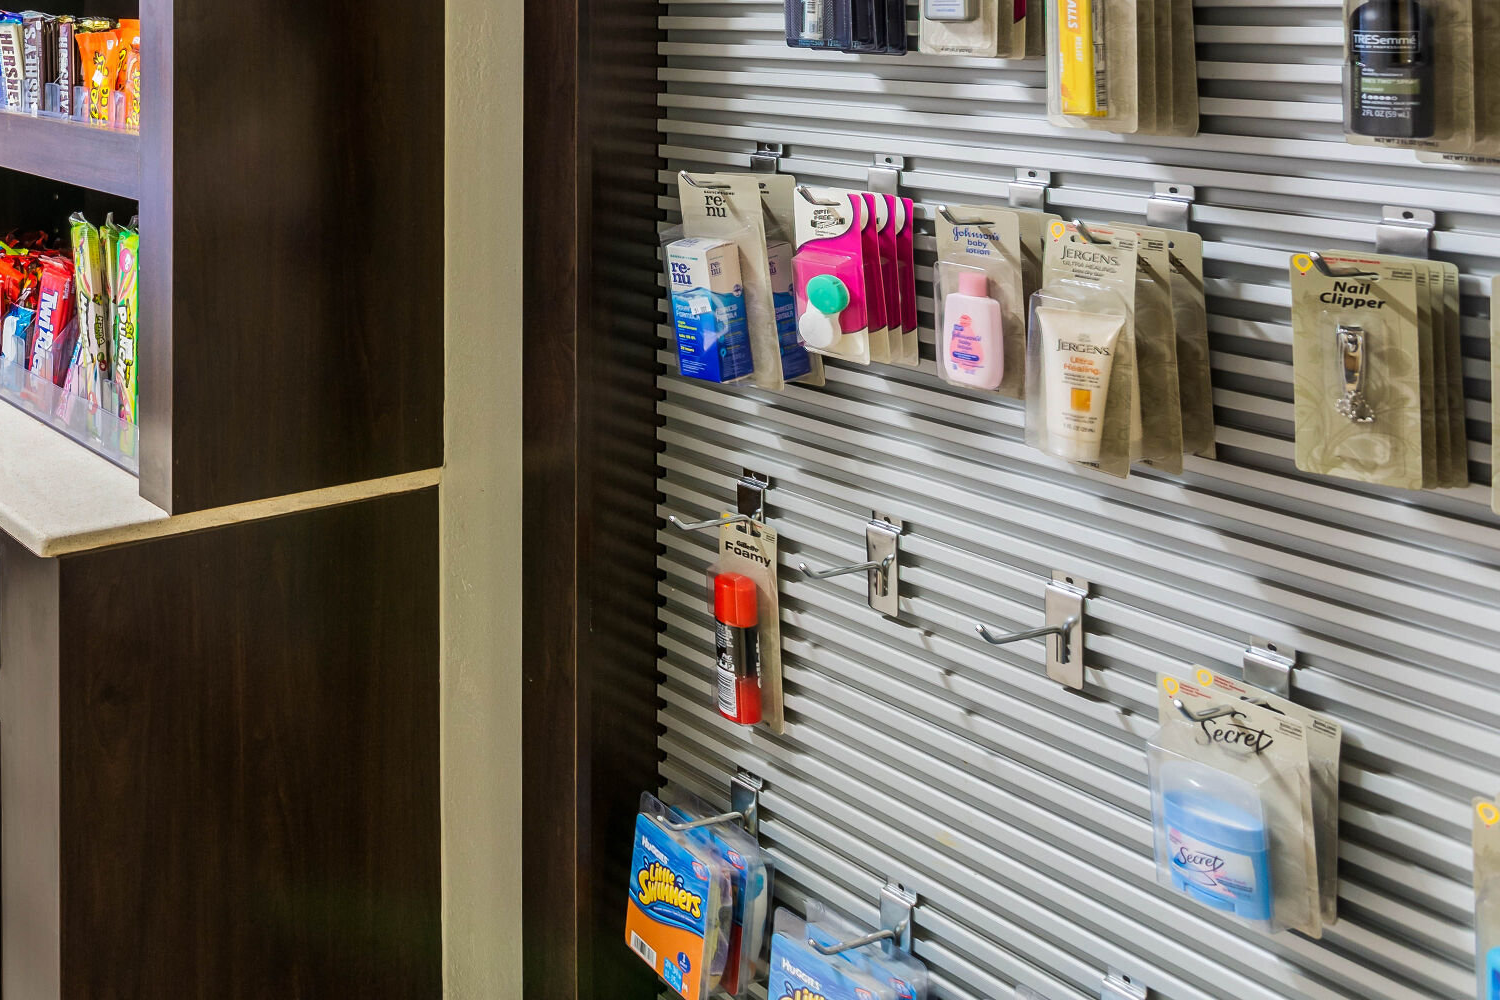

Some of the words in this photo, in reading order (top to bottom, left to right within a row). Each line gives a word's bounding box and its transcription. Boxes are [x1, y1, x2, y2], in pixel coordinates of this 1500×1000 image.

[1353, 33, 1417, 45] TRESemmé
[706, 206, 727, 218] nu
[952, 227, 1000, 241] Johnson's
[966, 247, 990, 256] lotion
[967, 239, 987, 249] baby
[1060, 245, 1119, 265] JERGENS
[672, 273, 692, 285] nu
[1333, 281, 1370, 295] Nail
[1320, 292, 1386, 310] Clipper
[1056, 339, 1111, 356] JERGENS
[725, 540, 771, 568] Foamy
[736, 540, 759, 552] Gillette
[1195, 713, 1273, 756] Secret
[642, 835, 669, 865] HUGGIES
[1178, 847, 1224, 872] Secret
[649, 861, 675, 884] Little
[781, 957, 822, 991] HUGGIES
